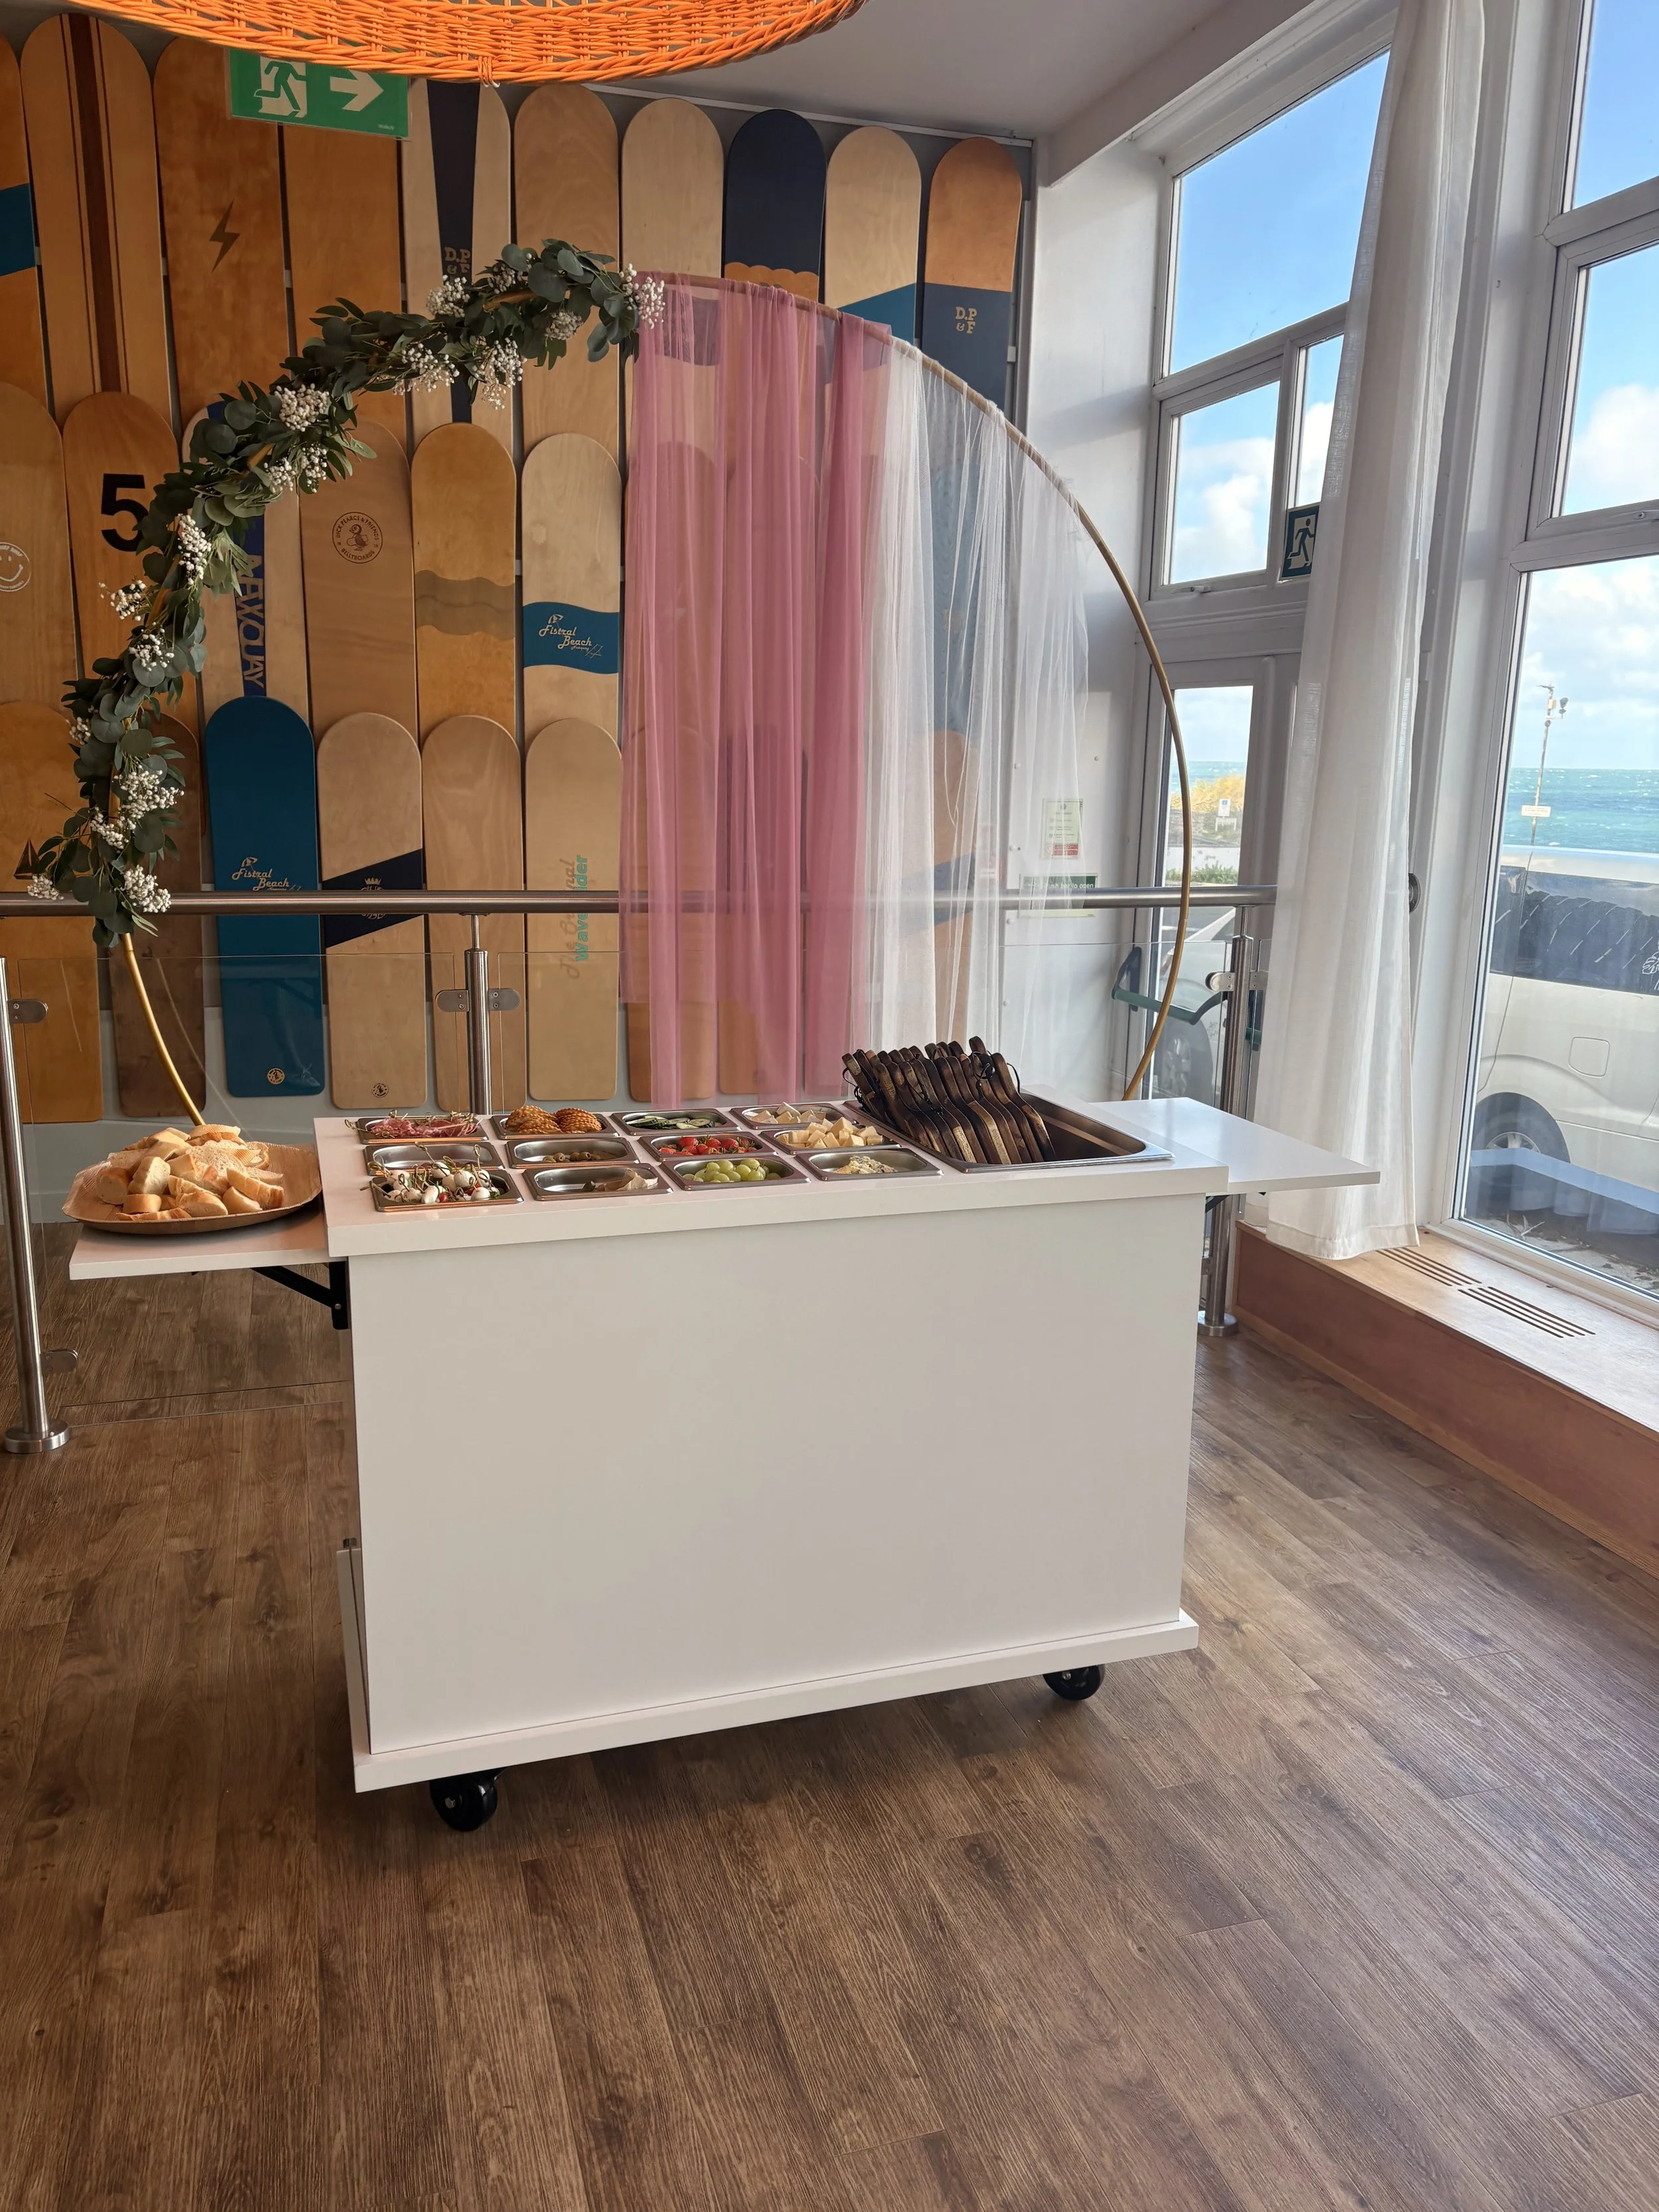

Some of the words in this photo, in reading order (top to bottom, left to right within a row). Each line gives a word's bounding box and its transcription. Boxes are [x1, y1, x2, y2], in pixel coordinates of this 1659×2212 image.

[101, 473, 149, 552] 5
[340, 516, 360, 526] PEARCE
[365, 519, 379, 541] FRIENDS
[539, 625, 577, 637] Fistral
[557, 635, 592, 649] Beach
[231, 868, 273, 881] Fistral
[253, 877, 289, 891] Beach
[559, 858, 578, 936] Ornal
[573, 854, 589, 962] Waveider
